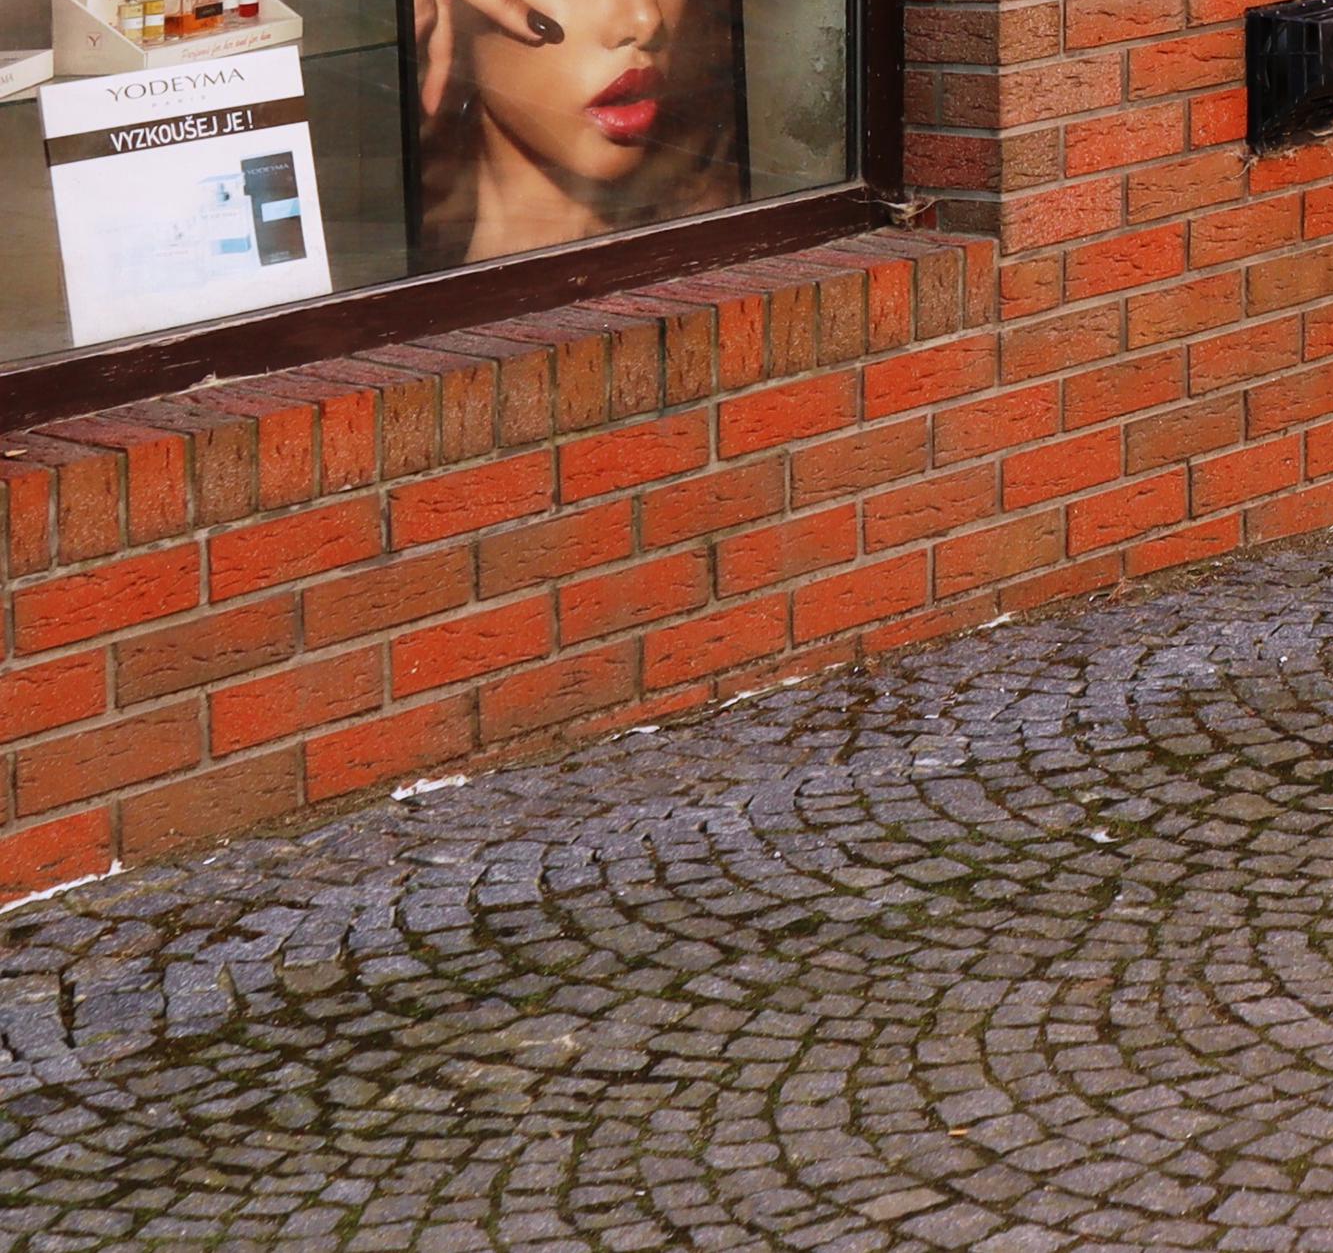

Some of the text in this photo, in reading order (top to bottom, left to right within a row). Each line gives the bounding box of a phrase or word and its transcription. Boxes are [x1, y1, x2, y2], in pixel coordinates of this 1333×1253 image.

[106, 67, 246, 103] YODEYMA
[109, 115, 218, 153] VYZKOUŠEJ
[222, 110, 245, 134] JE
